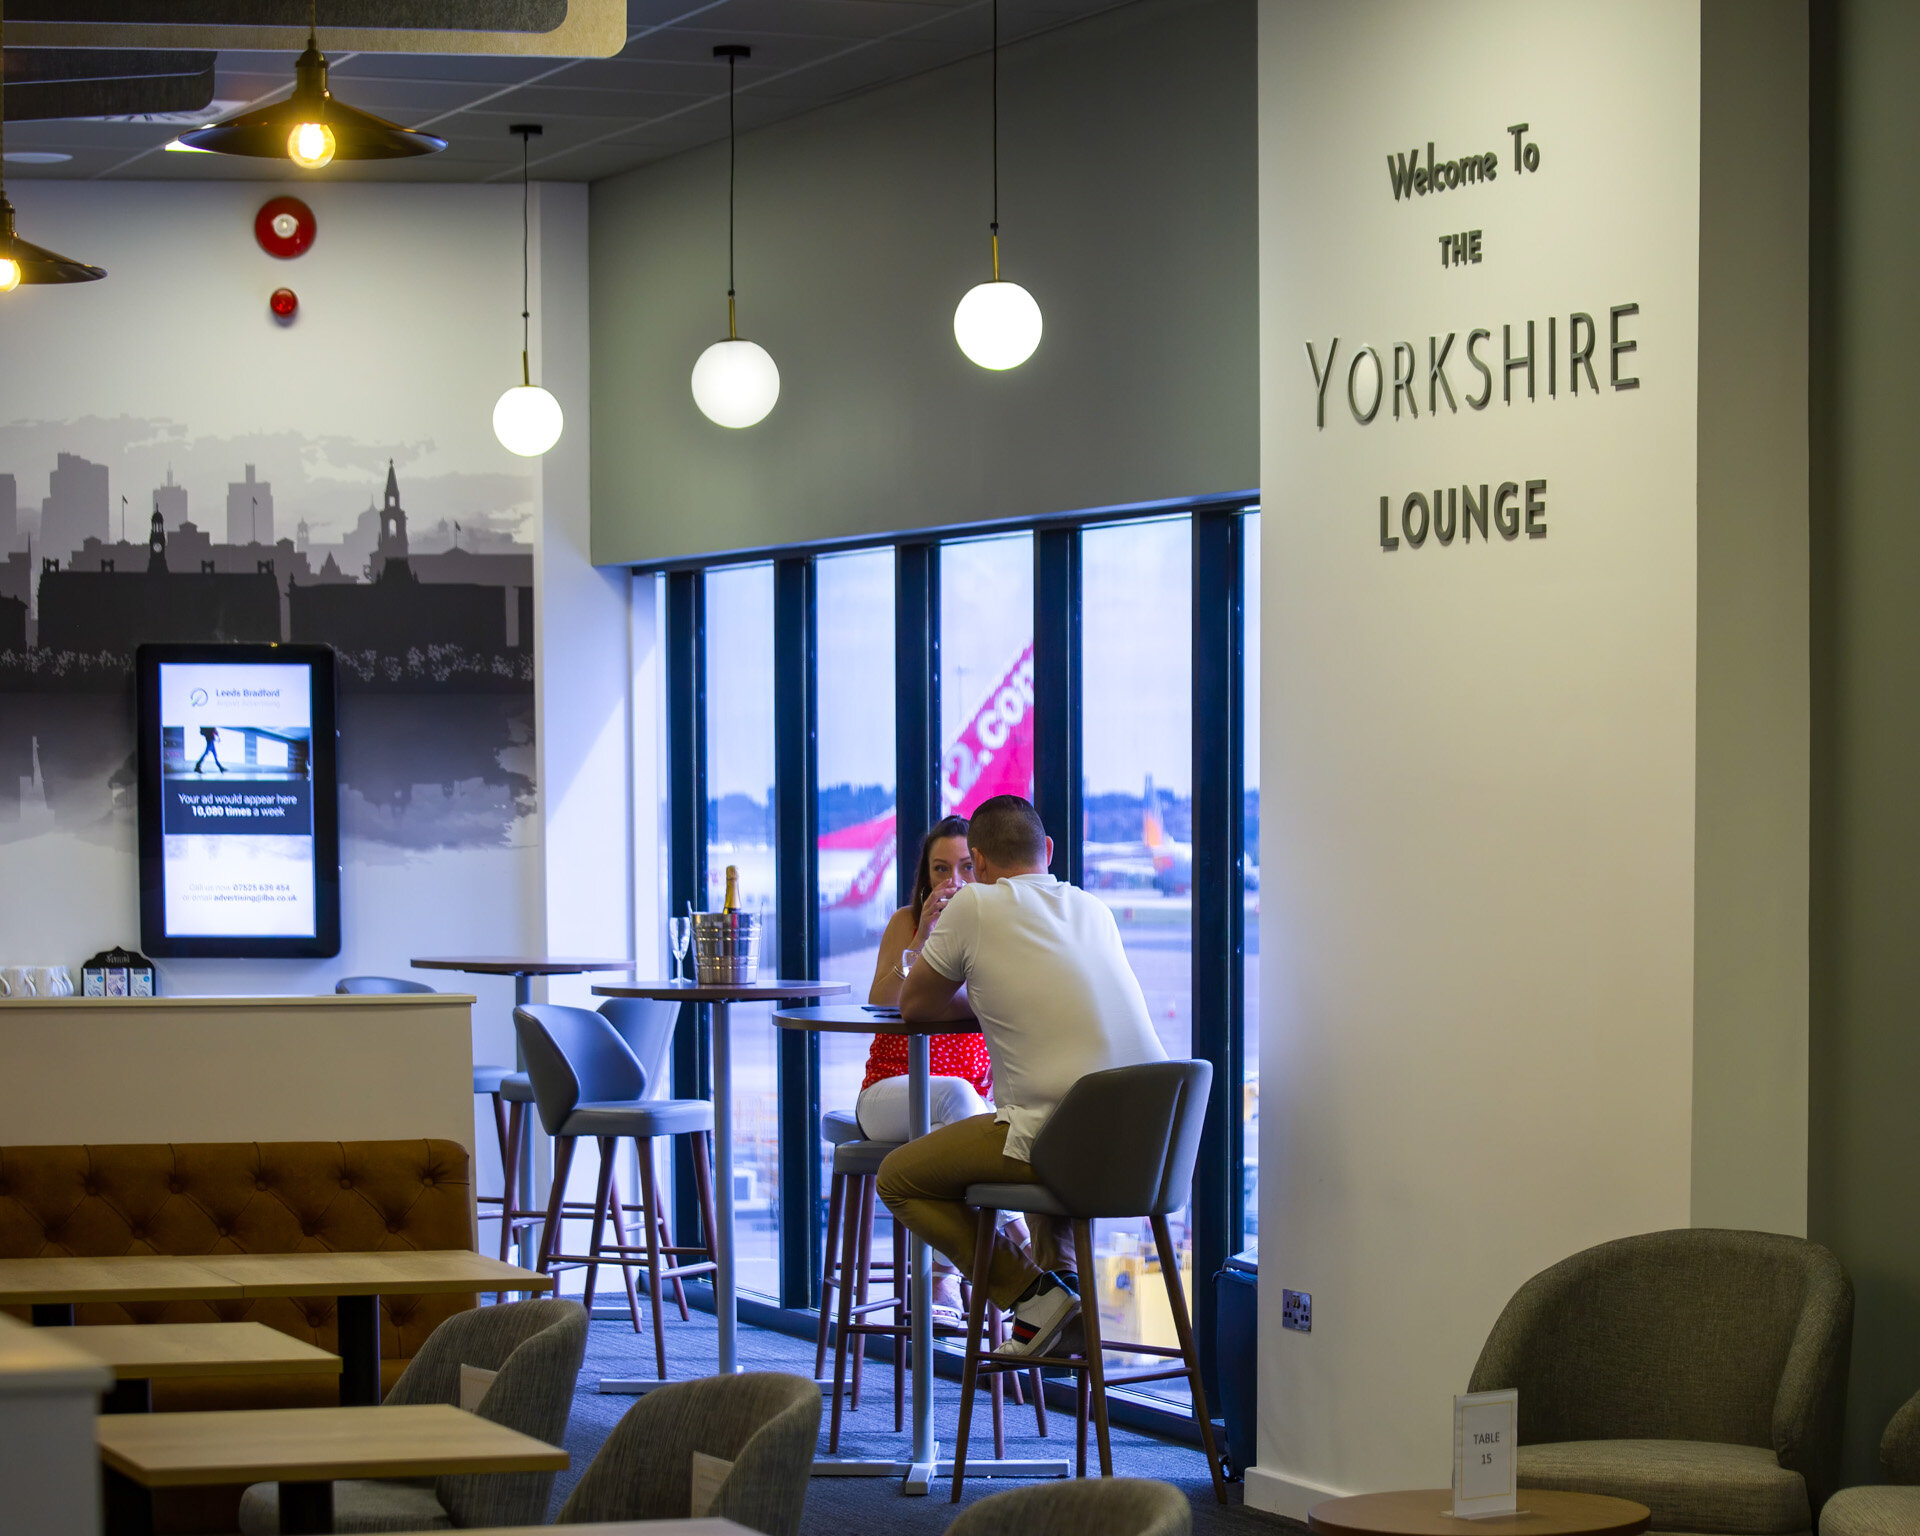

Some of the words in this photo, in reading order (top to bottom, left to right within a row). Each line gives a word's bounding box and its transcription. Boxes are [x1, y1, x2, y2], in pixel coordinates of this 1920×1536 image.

[1387, 141, 1497, 202] Welcome
[1507, 123, 1540, 174] To
[1439, 230, 1482, 268] THE
[1305, 302, 1639, 430] YORKSHIRE
[1380, 479, 1546, 552] LOUNGE
[216, 688, 241, 697] Leeds
[243, 688, 280, 697] Bradford
[178, 793, 200, 804] Your
[201, 794, 213, 804] ad
[214, 793, 242, 804] would
[243, 795, 275, 806] appear
[276, 793, 297, 804] here
[225, 805, 252, 816] times
[252, 807, 260, 816] a
[260, 806, 285, 817] week
[1473, 1432, 1500, 1445] TABLE
[1481, 1453, 1492, 1465] 15
